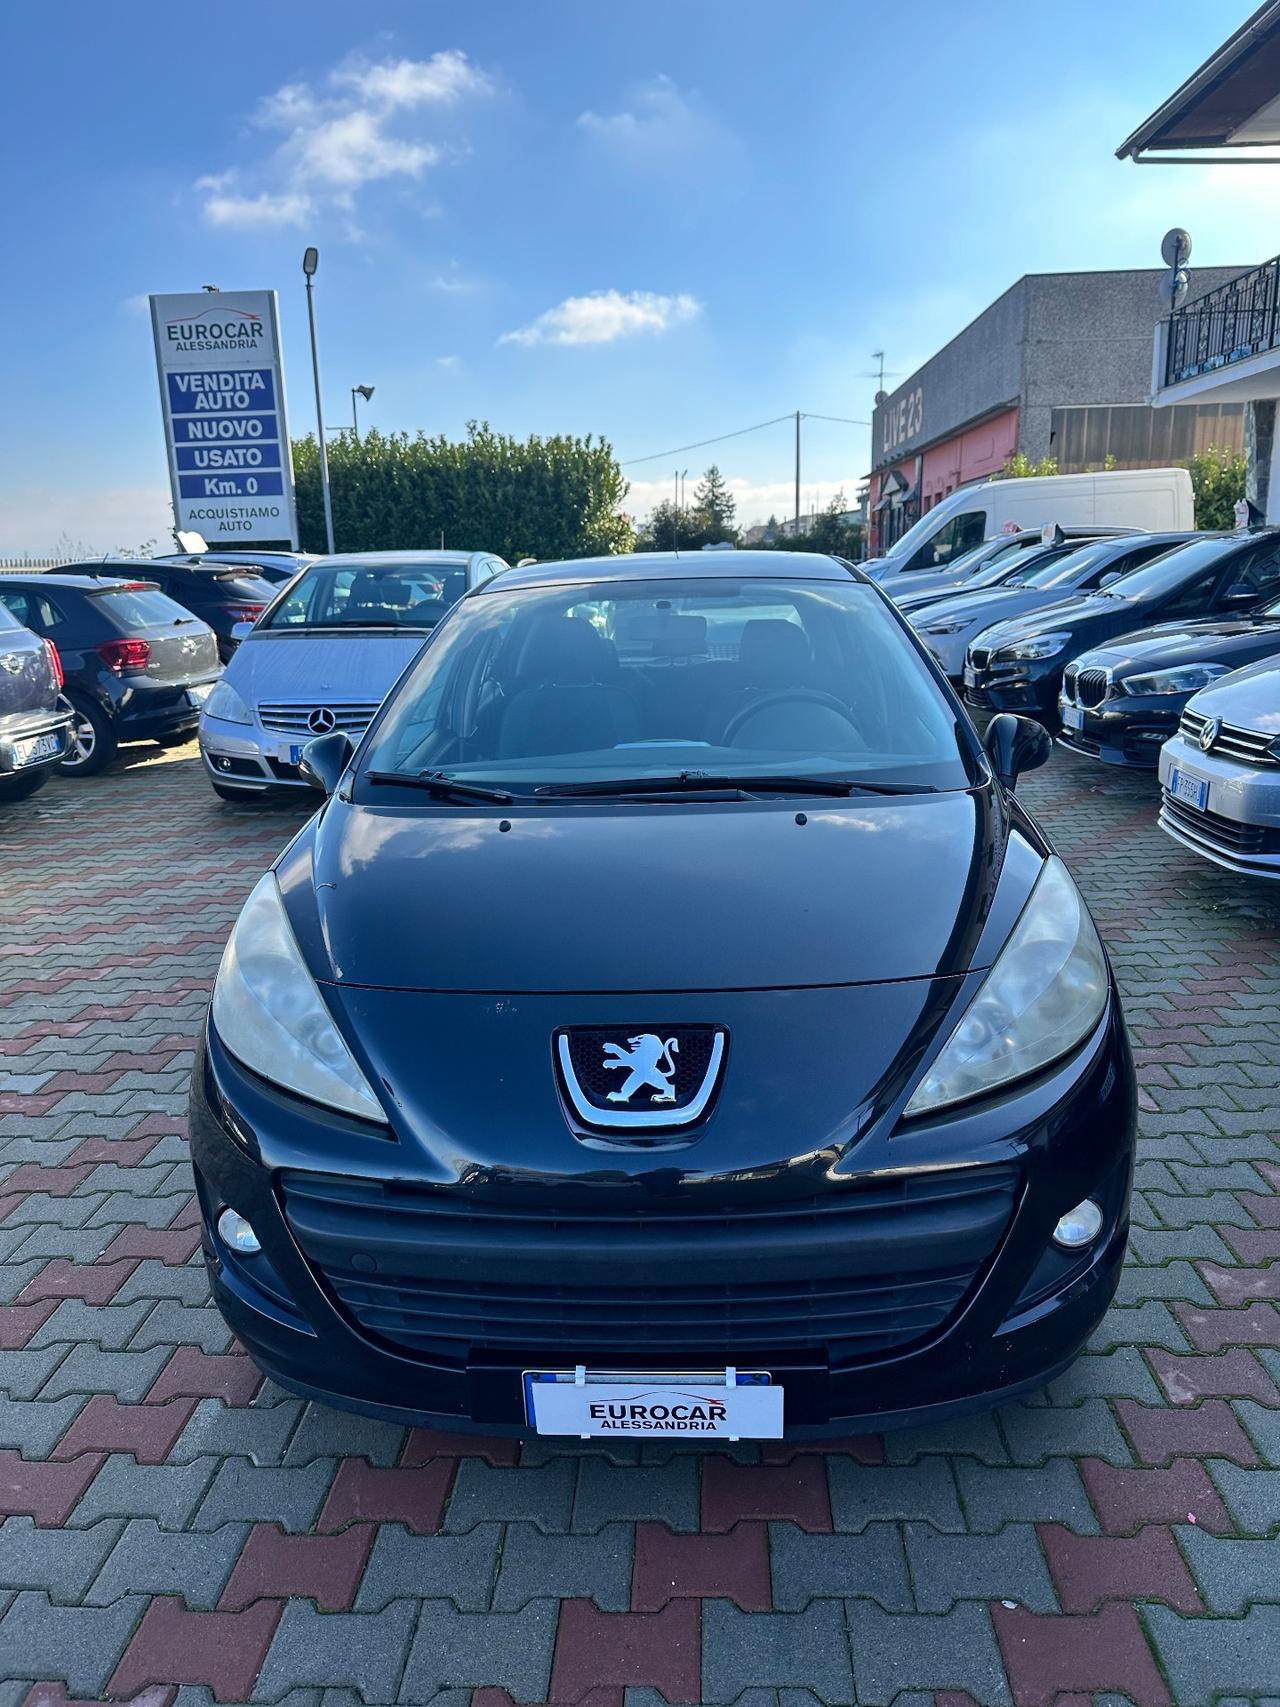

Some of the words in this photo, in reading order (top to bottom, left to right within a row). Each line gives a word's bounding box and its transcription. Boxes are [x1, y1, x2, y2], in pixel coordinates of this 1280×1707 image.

[167, 322, 263, 340] EUROCAR
[176, 339, 258, 352] ALESSANDRIA
[175, 372, 266, 393] VENDITA
[195, 391, 250, 410] AUTO
[187, 419, 263, 439] NUOVO
[883, 387, 923, 453] LIVE23
[194, 448, 262, 467] USATO
[204, 478, 241, 495] Km.
[246, 477, 258, 494] 0
[189, 506, 280, 520] ACQUISTIAMO
[218, 520, 252, 532] AUTO
[589, 1404, 727, 1421] EUROCAR
[600, 1420, 717, 1431] ALESSANDRIA
